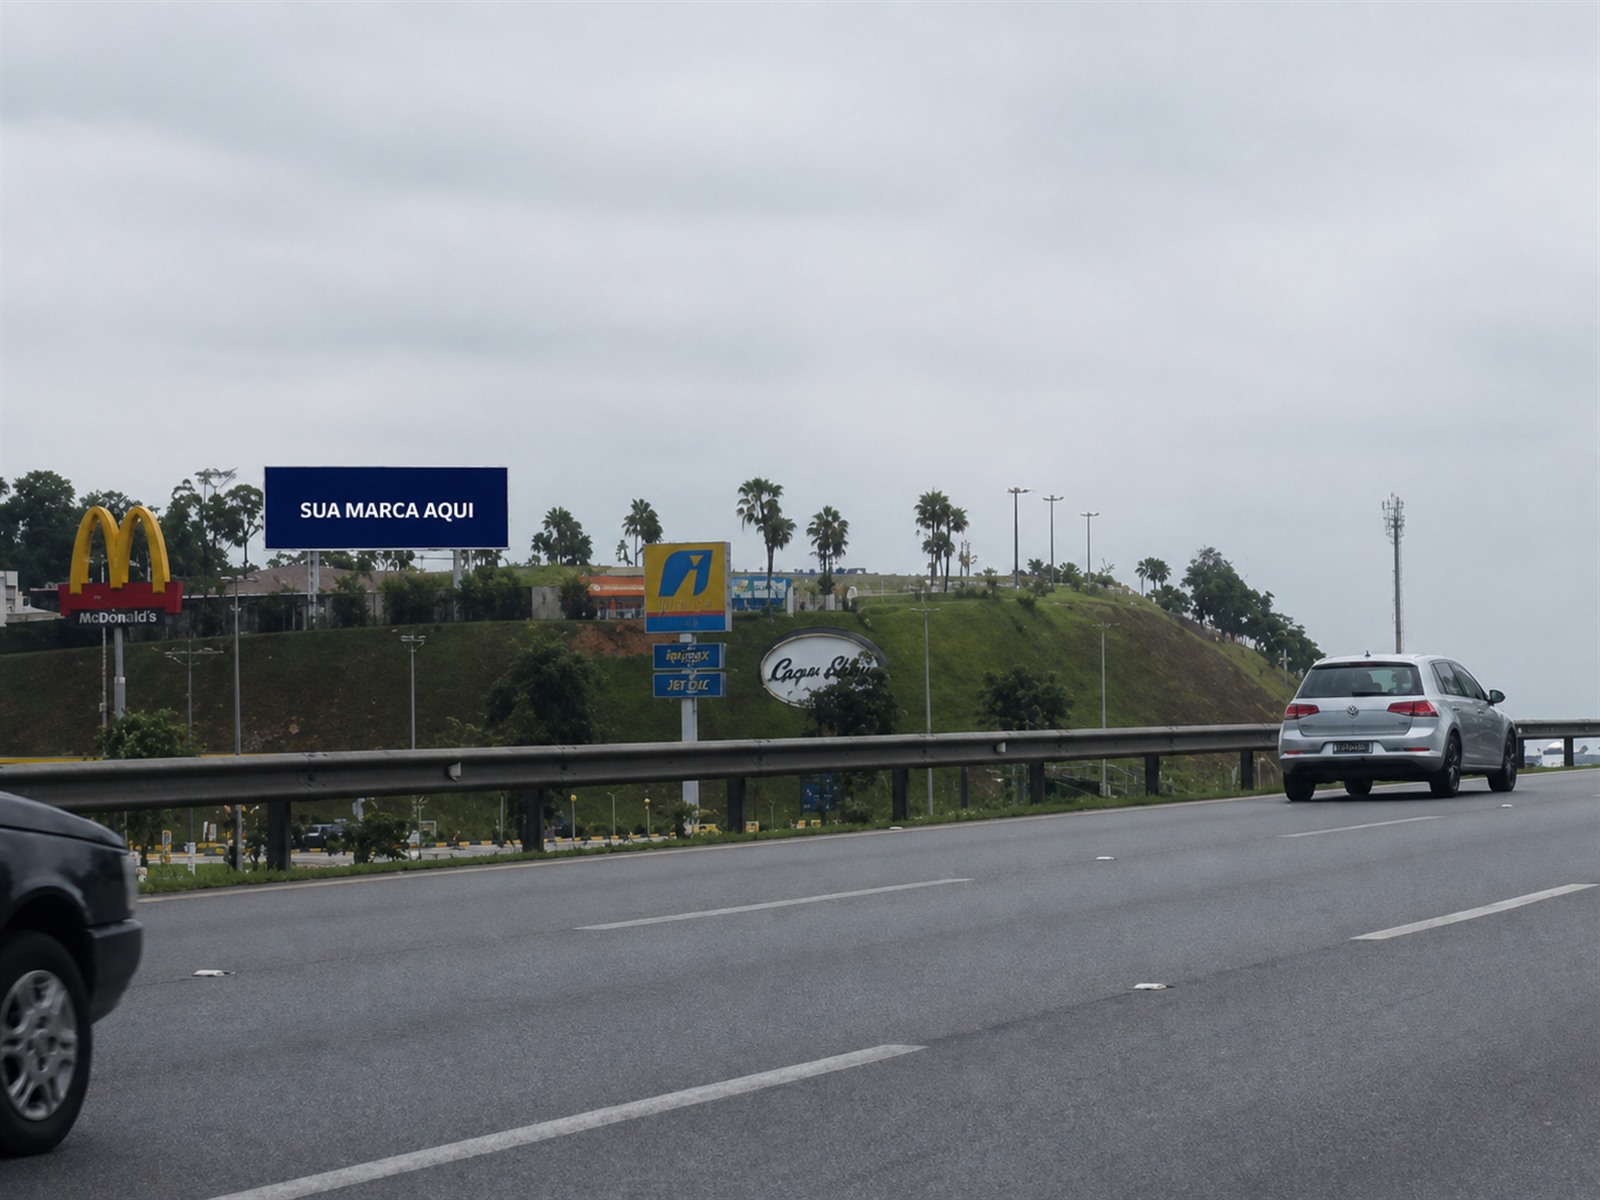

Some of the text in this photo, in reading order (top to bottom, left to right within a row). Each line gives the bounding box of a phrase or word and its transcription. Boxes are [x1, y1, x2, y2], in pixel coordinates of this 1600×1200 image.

[300, 502, 474, 522] SUA MARCA AQUI
[78, 610, 157, 624] McDonald's
[666, 680, 687, 691] JET
